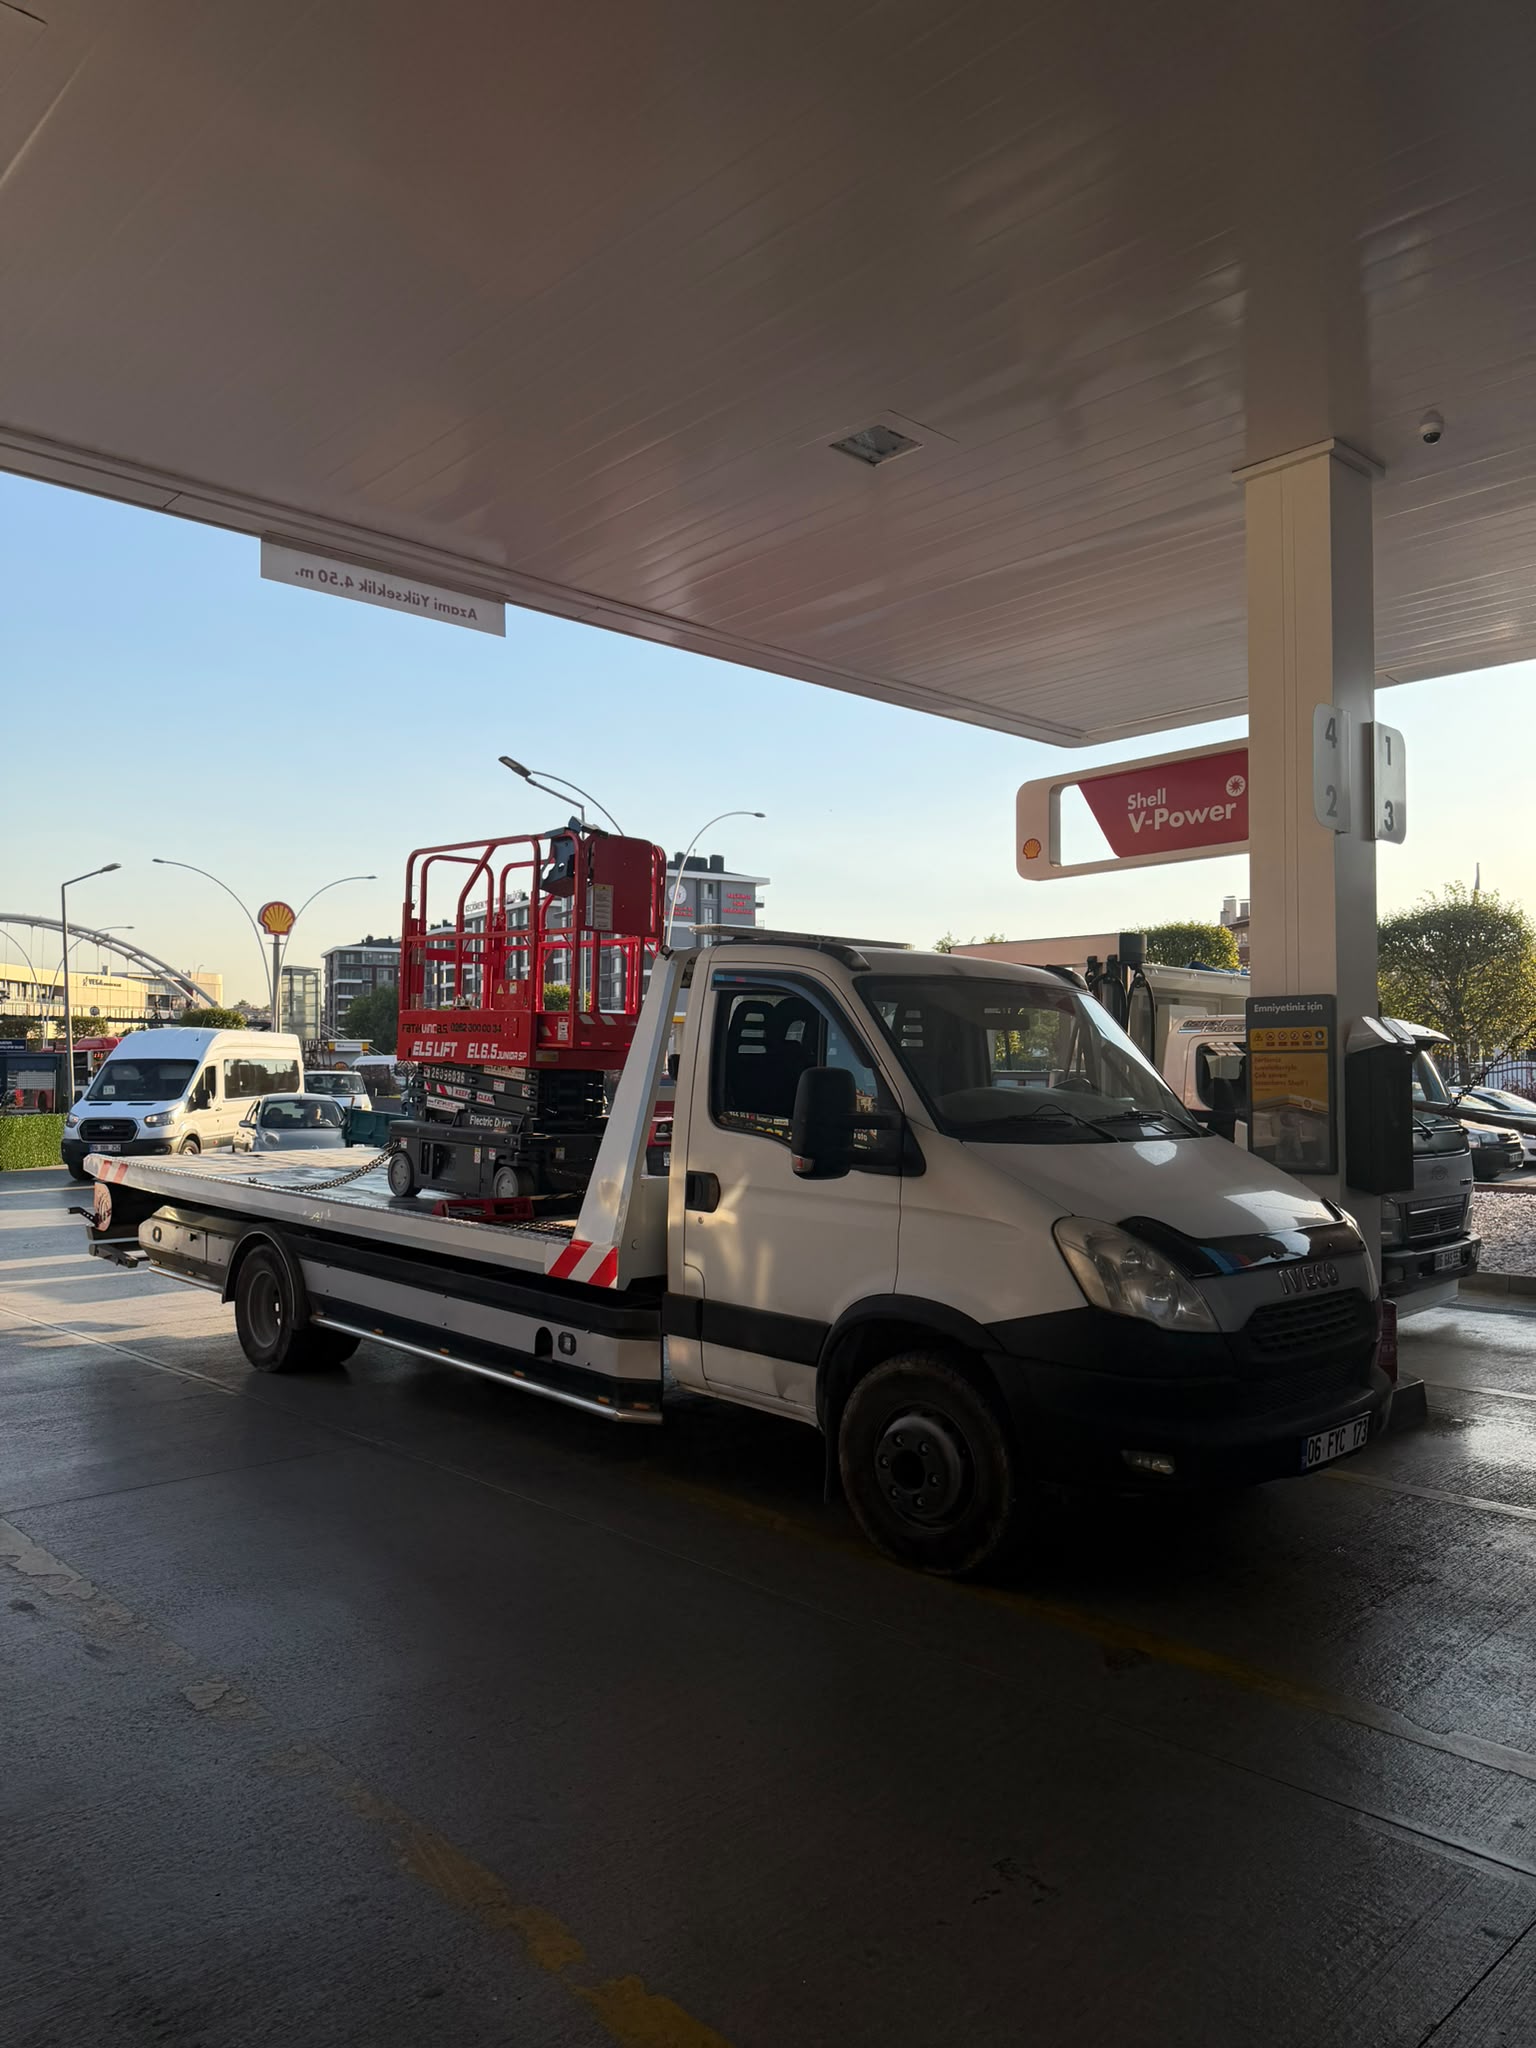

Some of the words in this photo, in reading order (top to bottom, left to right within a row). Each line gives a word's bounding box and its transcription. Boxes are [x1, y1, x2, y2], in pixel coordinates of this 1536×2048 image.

[1325, 717, 1338, 749] 4
[1385, 735, 1392, 767] 1
[1127, 787, 1166, 811] Shell
[1326, 784, 1338, 818] 2
[1127, 802, 1237, 834] V-Power
[1384, 799, 1394, 833] 3
[1253, 1002, 1306, 1014] Emniyetiniz
[1307, 1001, 1324, 1013] için
[412, 1040, 433, 1057] ELS
[433, 1041, 458, 1058] LIFT
[469, 1114, 494, 1127] Electric
[1277, 1261, 1340, 1295] IVECO
[1307, 1437, 1323, 1465] 06
[1327, 1429, 1347, 1458] FYC
[1352, 1419, 1368, 1447] 173
